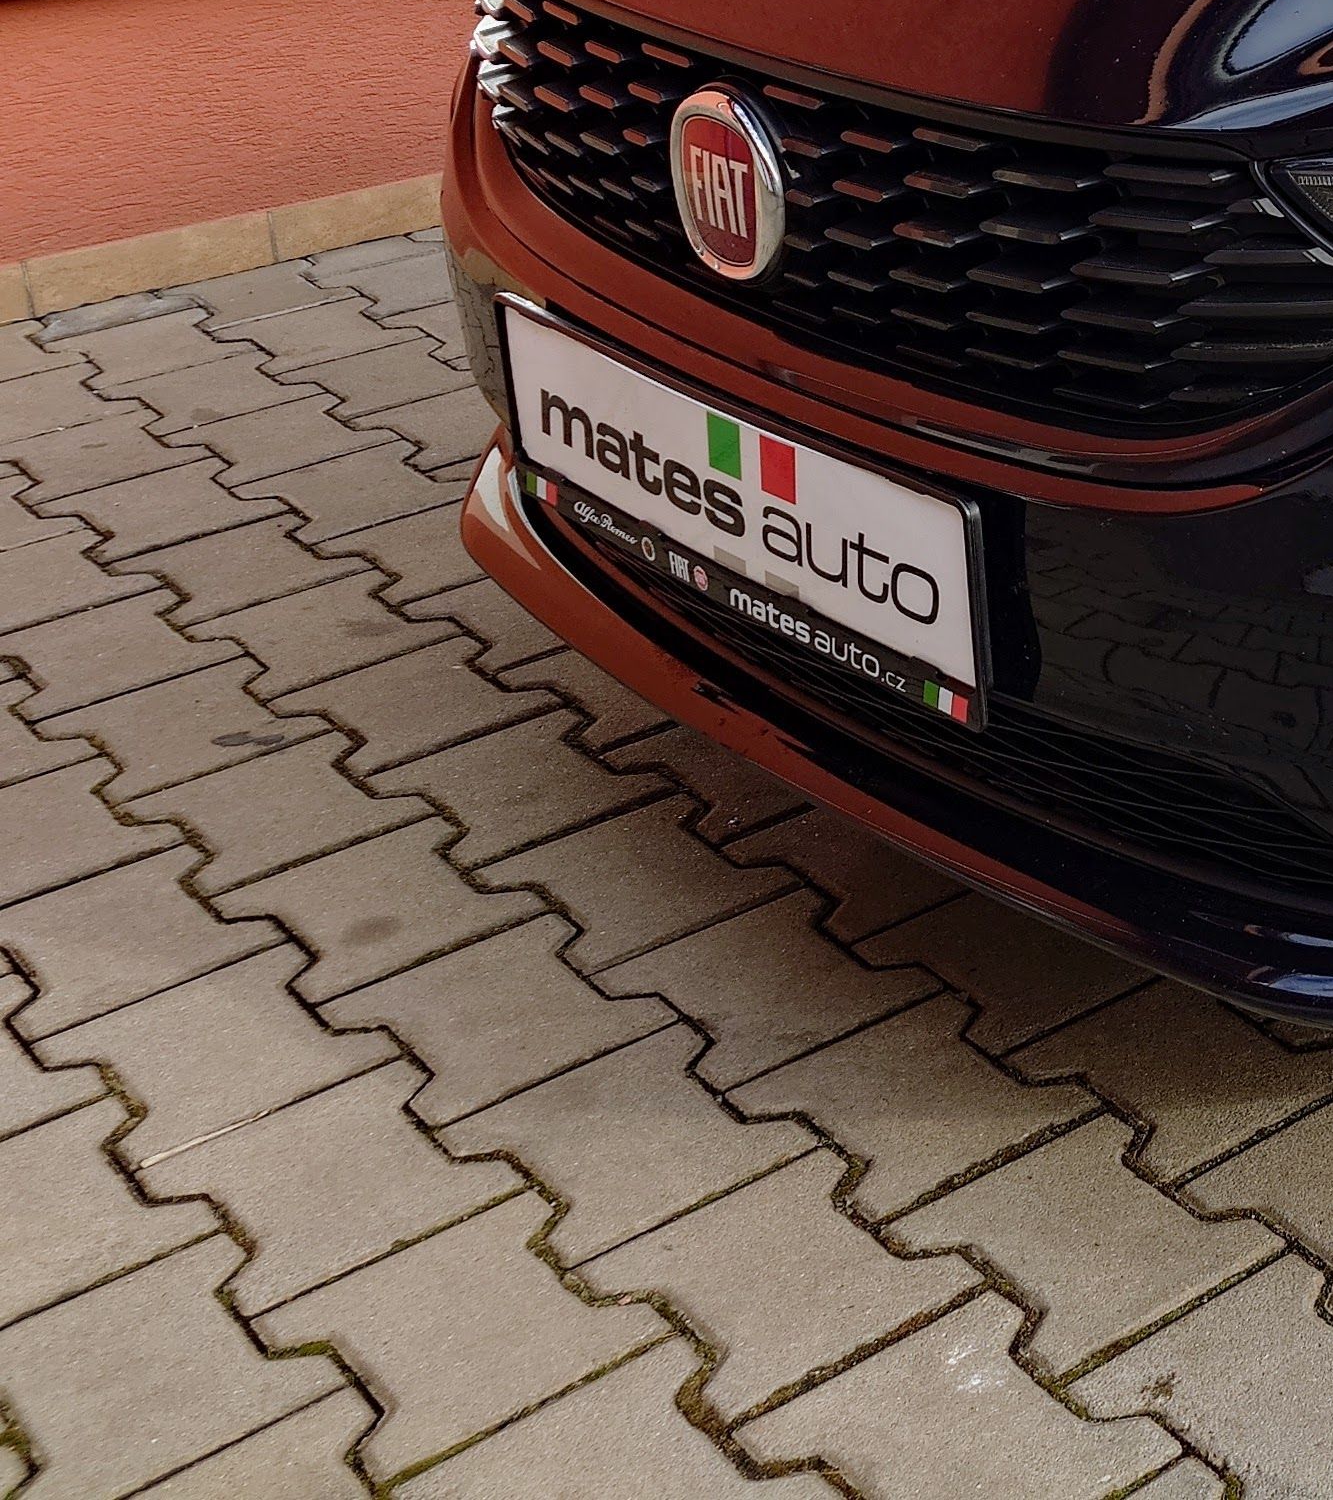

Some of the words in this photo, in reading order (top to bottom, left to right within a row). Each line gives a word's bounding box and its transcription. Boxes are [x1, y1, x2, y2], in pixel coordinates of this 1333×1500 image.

[689, 143, 749, 240] FIAT
[539, 387, 747, 538] mates
[761, 504, 940, 626] auto
[668, 550, 690, 583] FIAT
